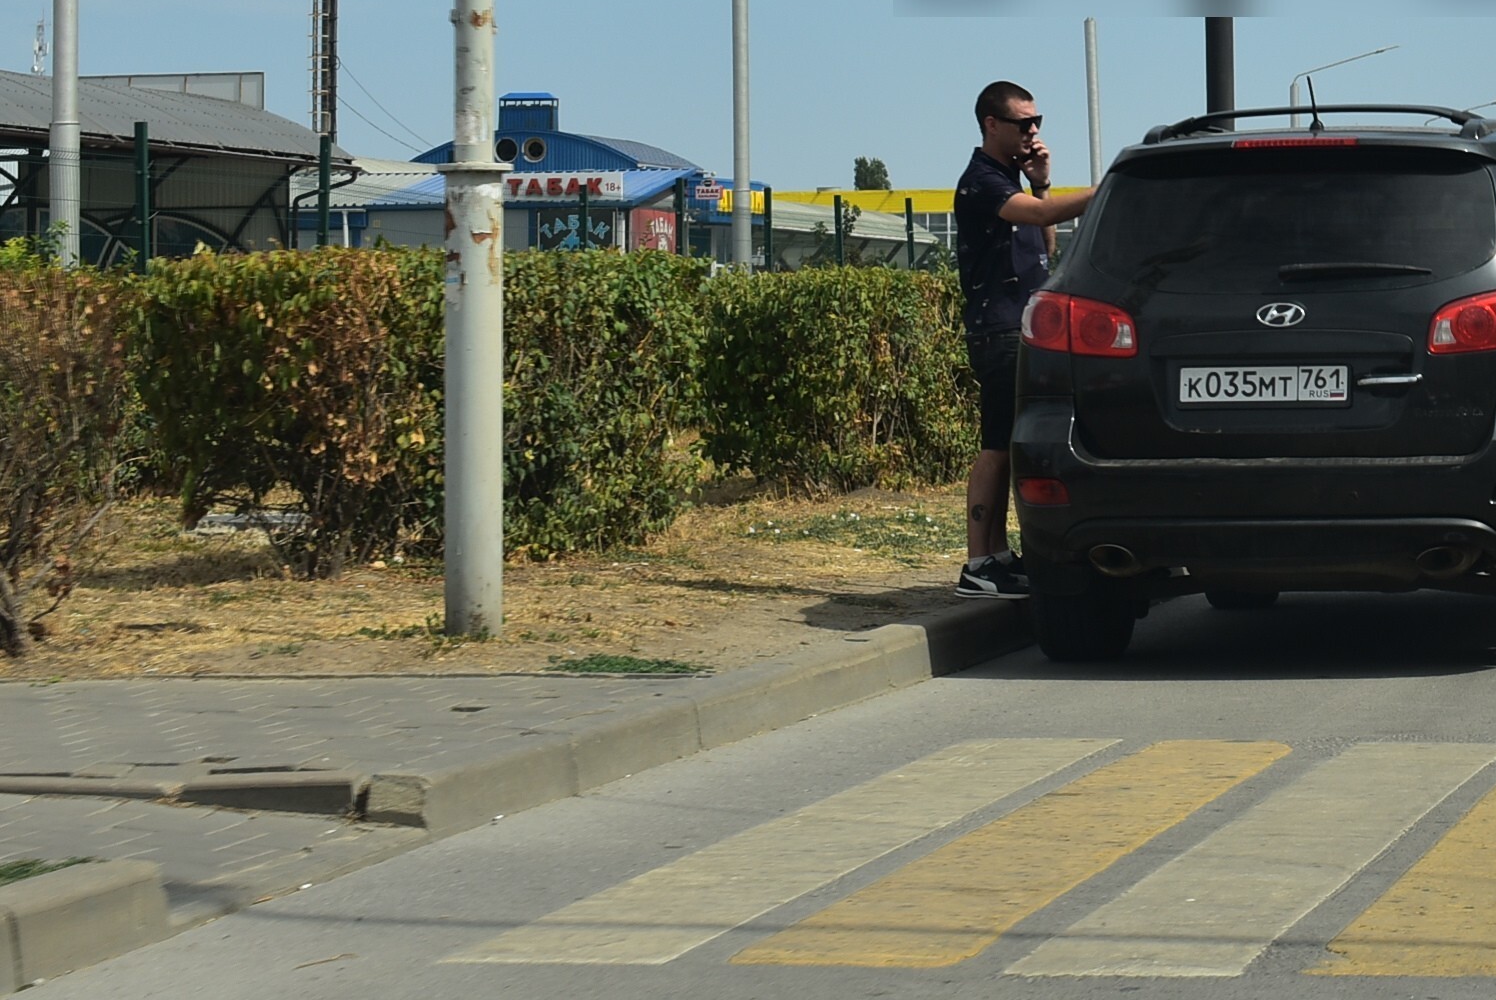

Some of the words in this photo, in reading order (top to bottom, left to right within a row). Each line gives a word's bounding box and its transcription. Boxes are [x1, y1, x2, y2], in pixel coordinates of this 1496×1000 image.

[507, 177, 603, 196] ТАБАК
[605, 182, 621, 193] 18+
[1188, 371, 1293, 398] К035МТ
[1301, 369, 1340, 390] 761
[1309, 390, 1329, 398] RUS
